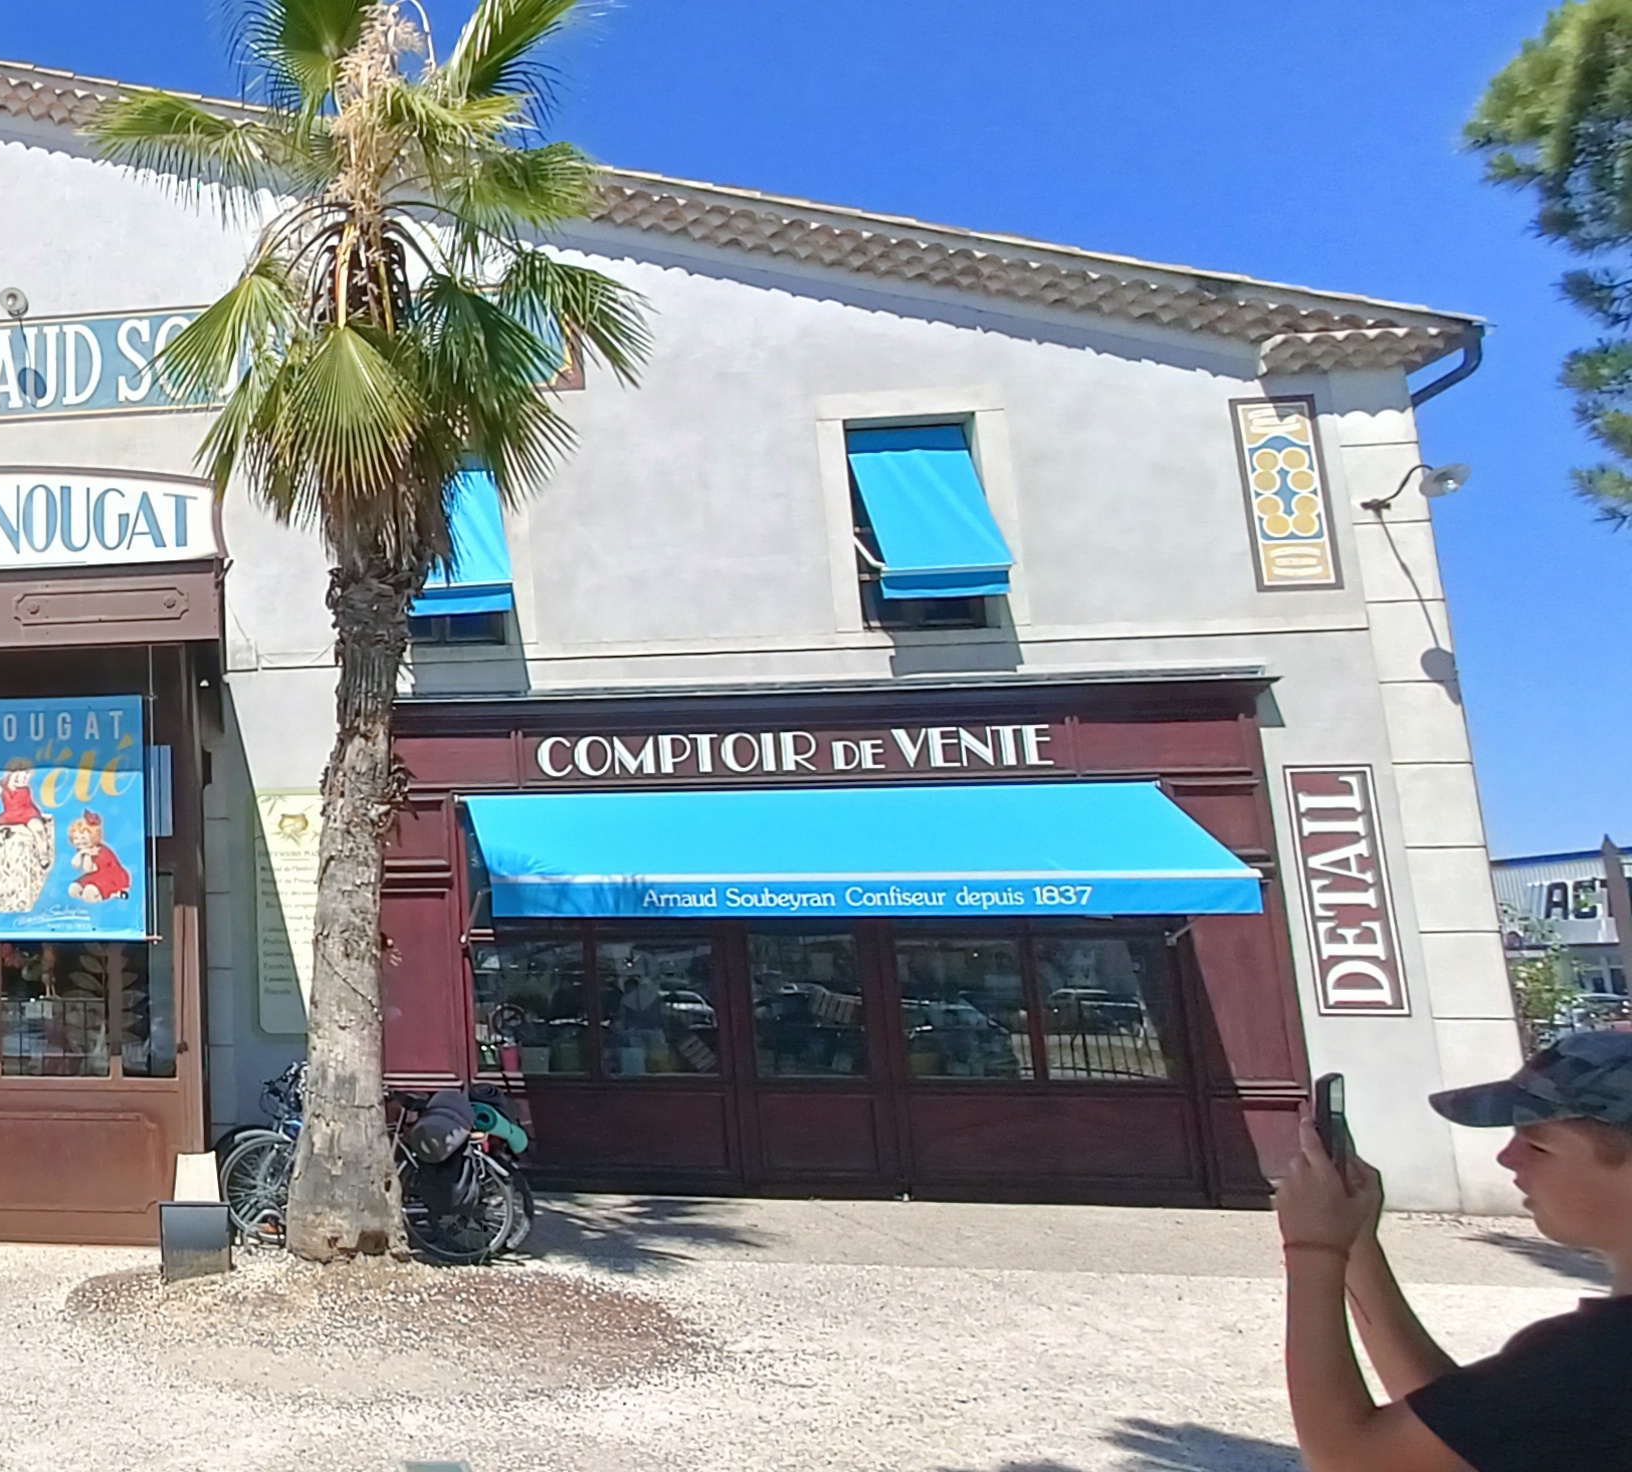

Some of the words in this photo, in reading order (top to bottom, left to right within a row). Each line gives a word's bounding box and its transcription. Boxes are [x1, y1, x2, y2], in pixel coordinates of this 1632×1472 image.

[536, 731, 818, 777] COMPTOIR
[831, 739, 886, 771] DE
[891, 723, 1055, 768] VENTE
[642, 888, 718, 909] Arnaud
[725, 887, 836, 912] Soubeyran
[845, 886, 946, 909] Confiseur
[955, 886, 1025, 909] depuis
[1033, 885, 1093, 906] 1837
[1297, 775, 1393, 1006] DETAIL
